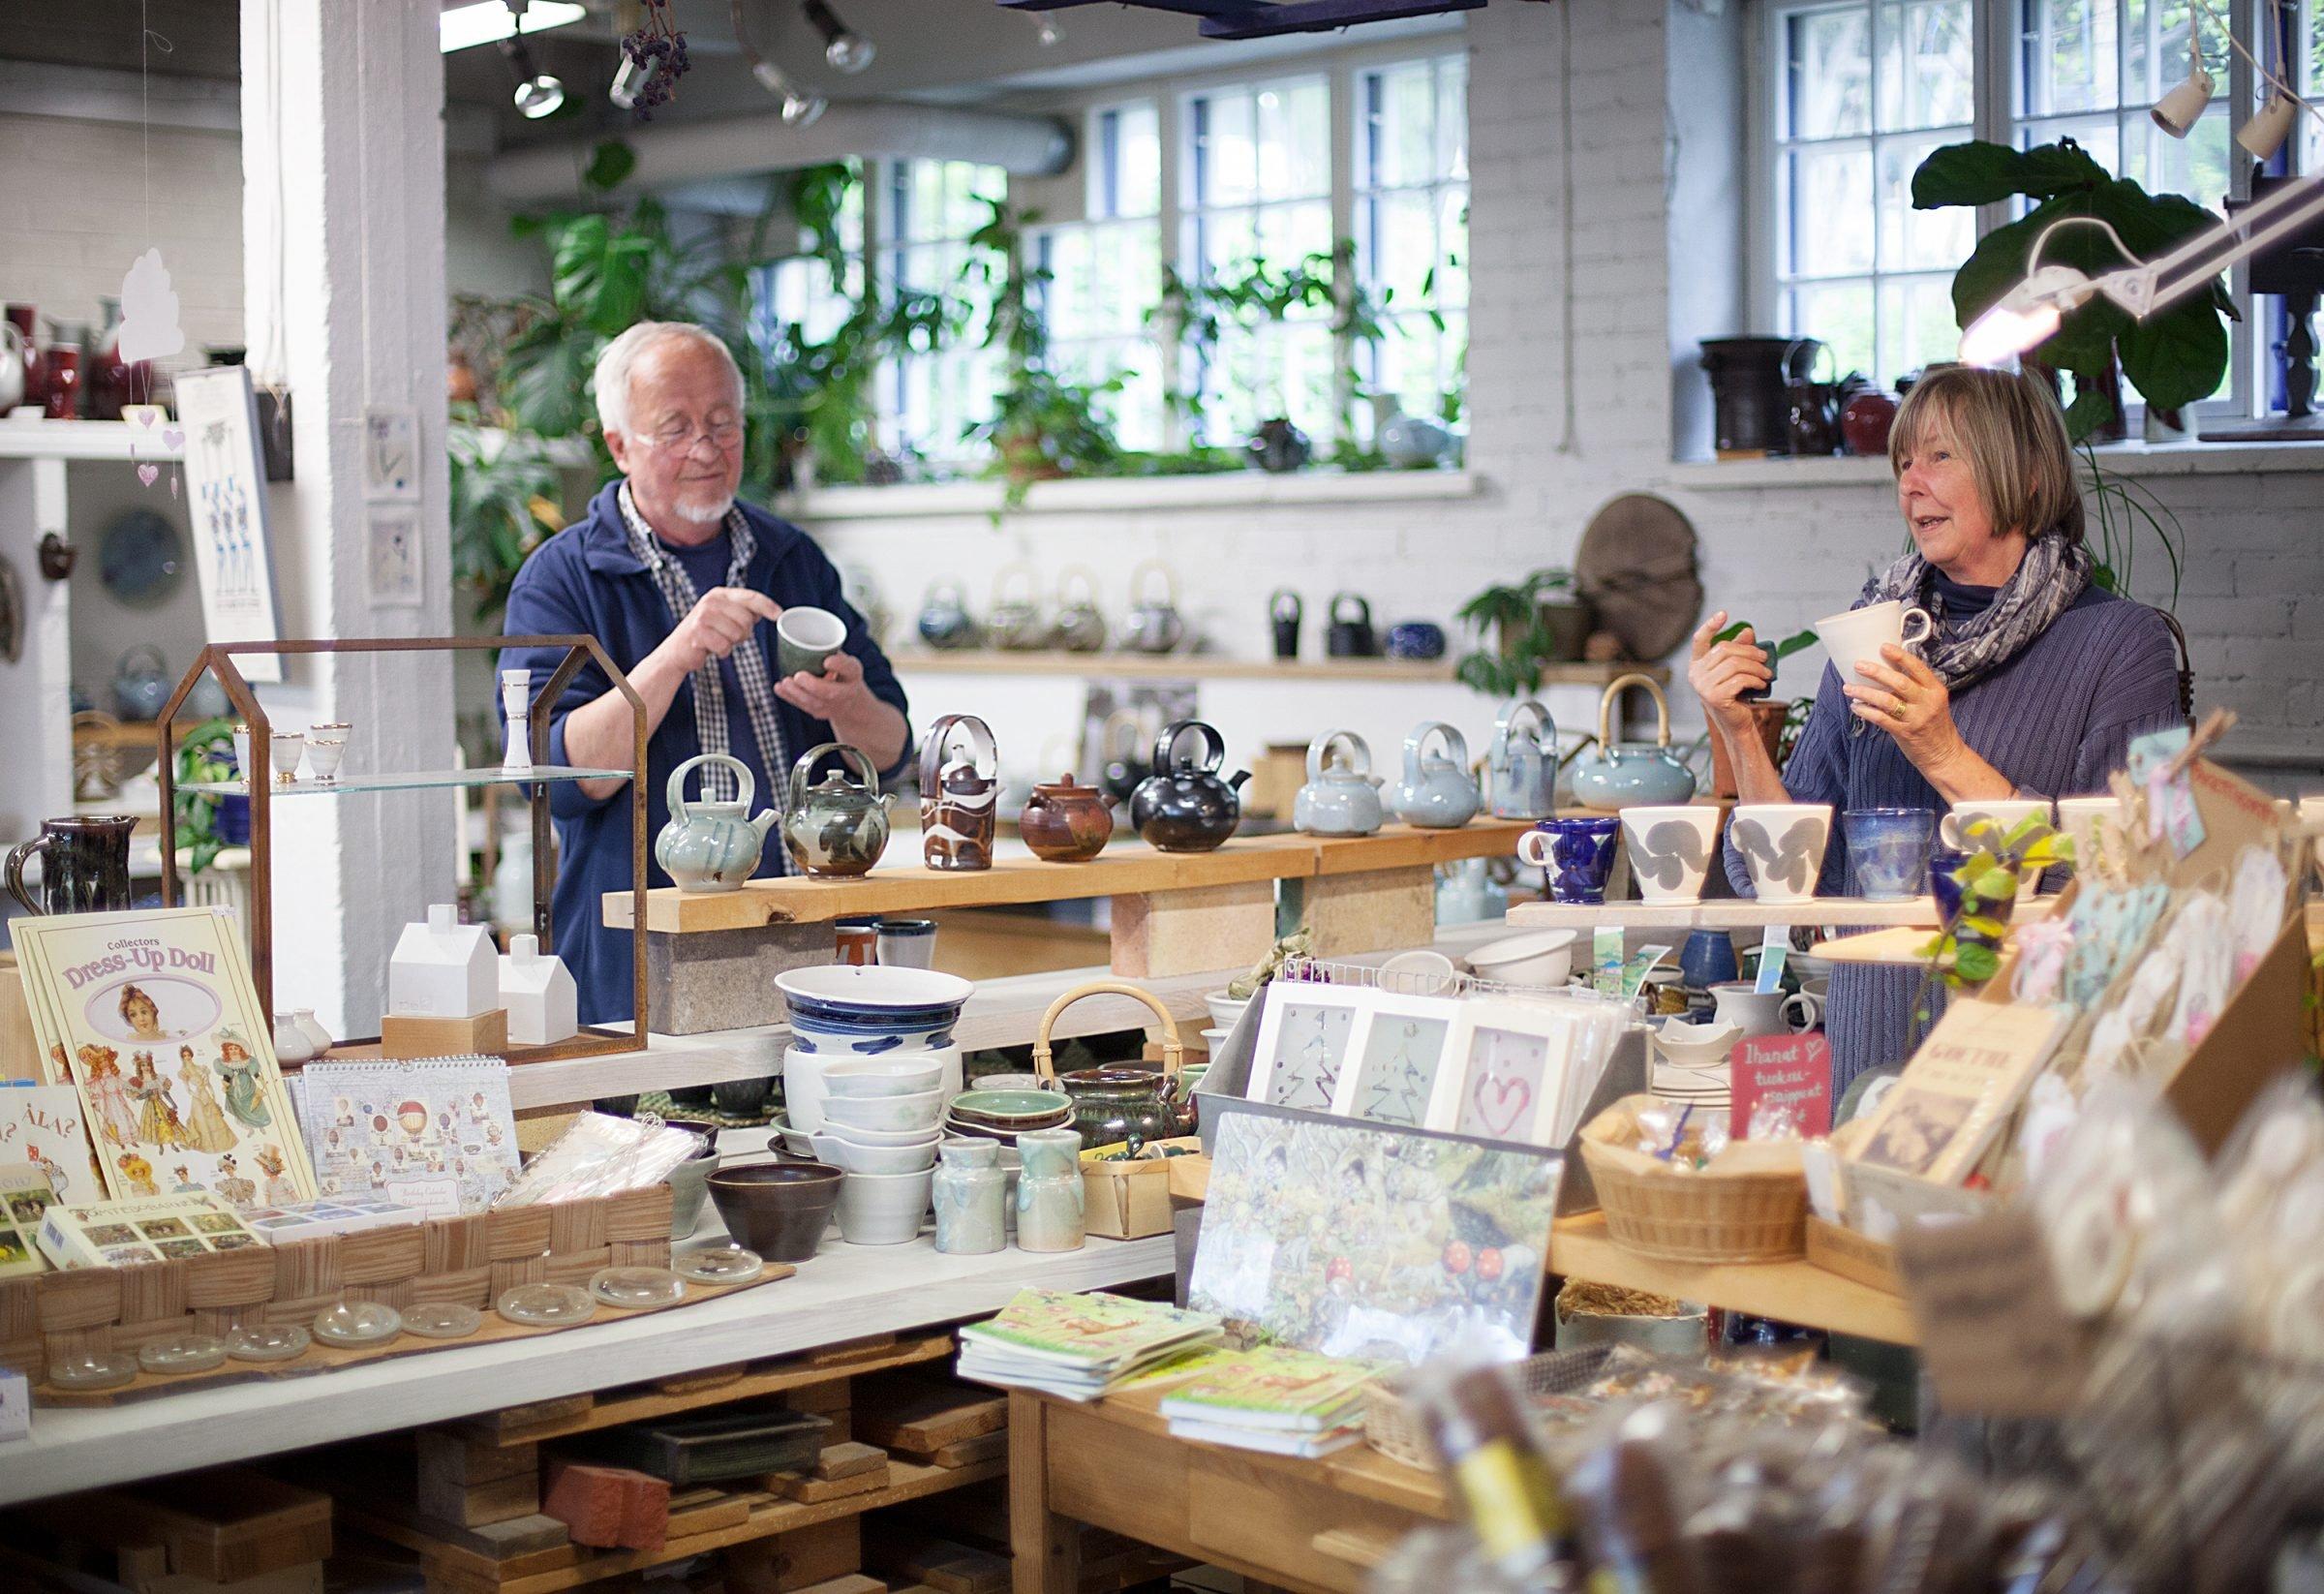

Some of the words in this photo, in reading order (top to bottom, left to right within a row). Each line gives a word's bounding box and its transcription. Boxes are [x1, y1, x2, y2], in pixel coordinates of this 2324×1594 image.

[107, 937, 160, 951] Collectors
[62, 947, 166, 990] Dress-Up
[168, 947, 216, 975] Doll
[1745, 1043, 1799, 1064] Ihanat
